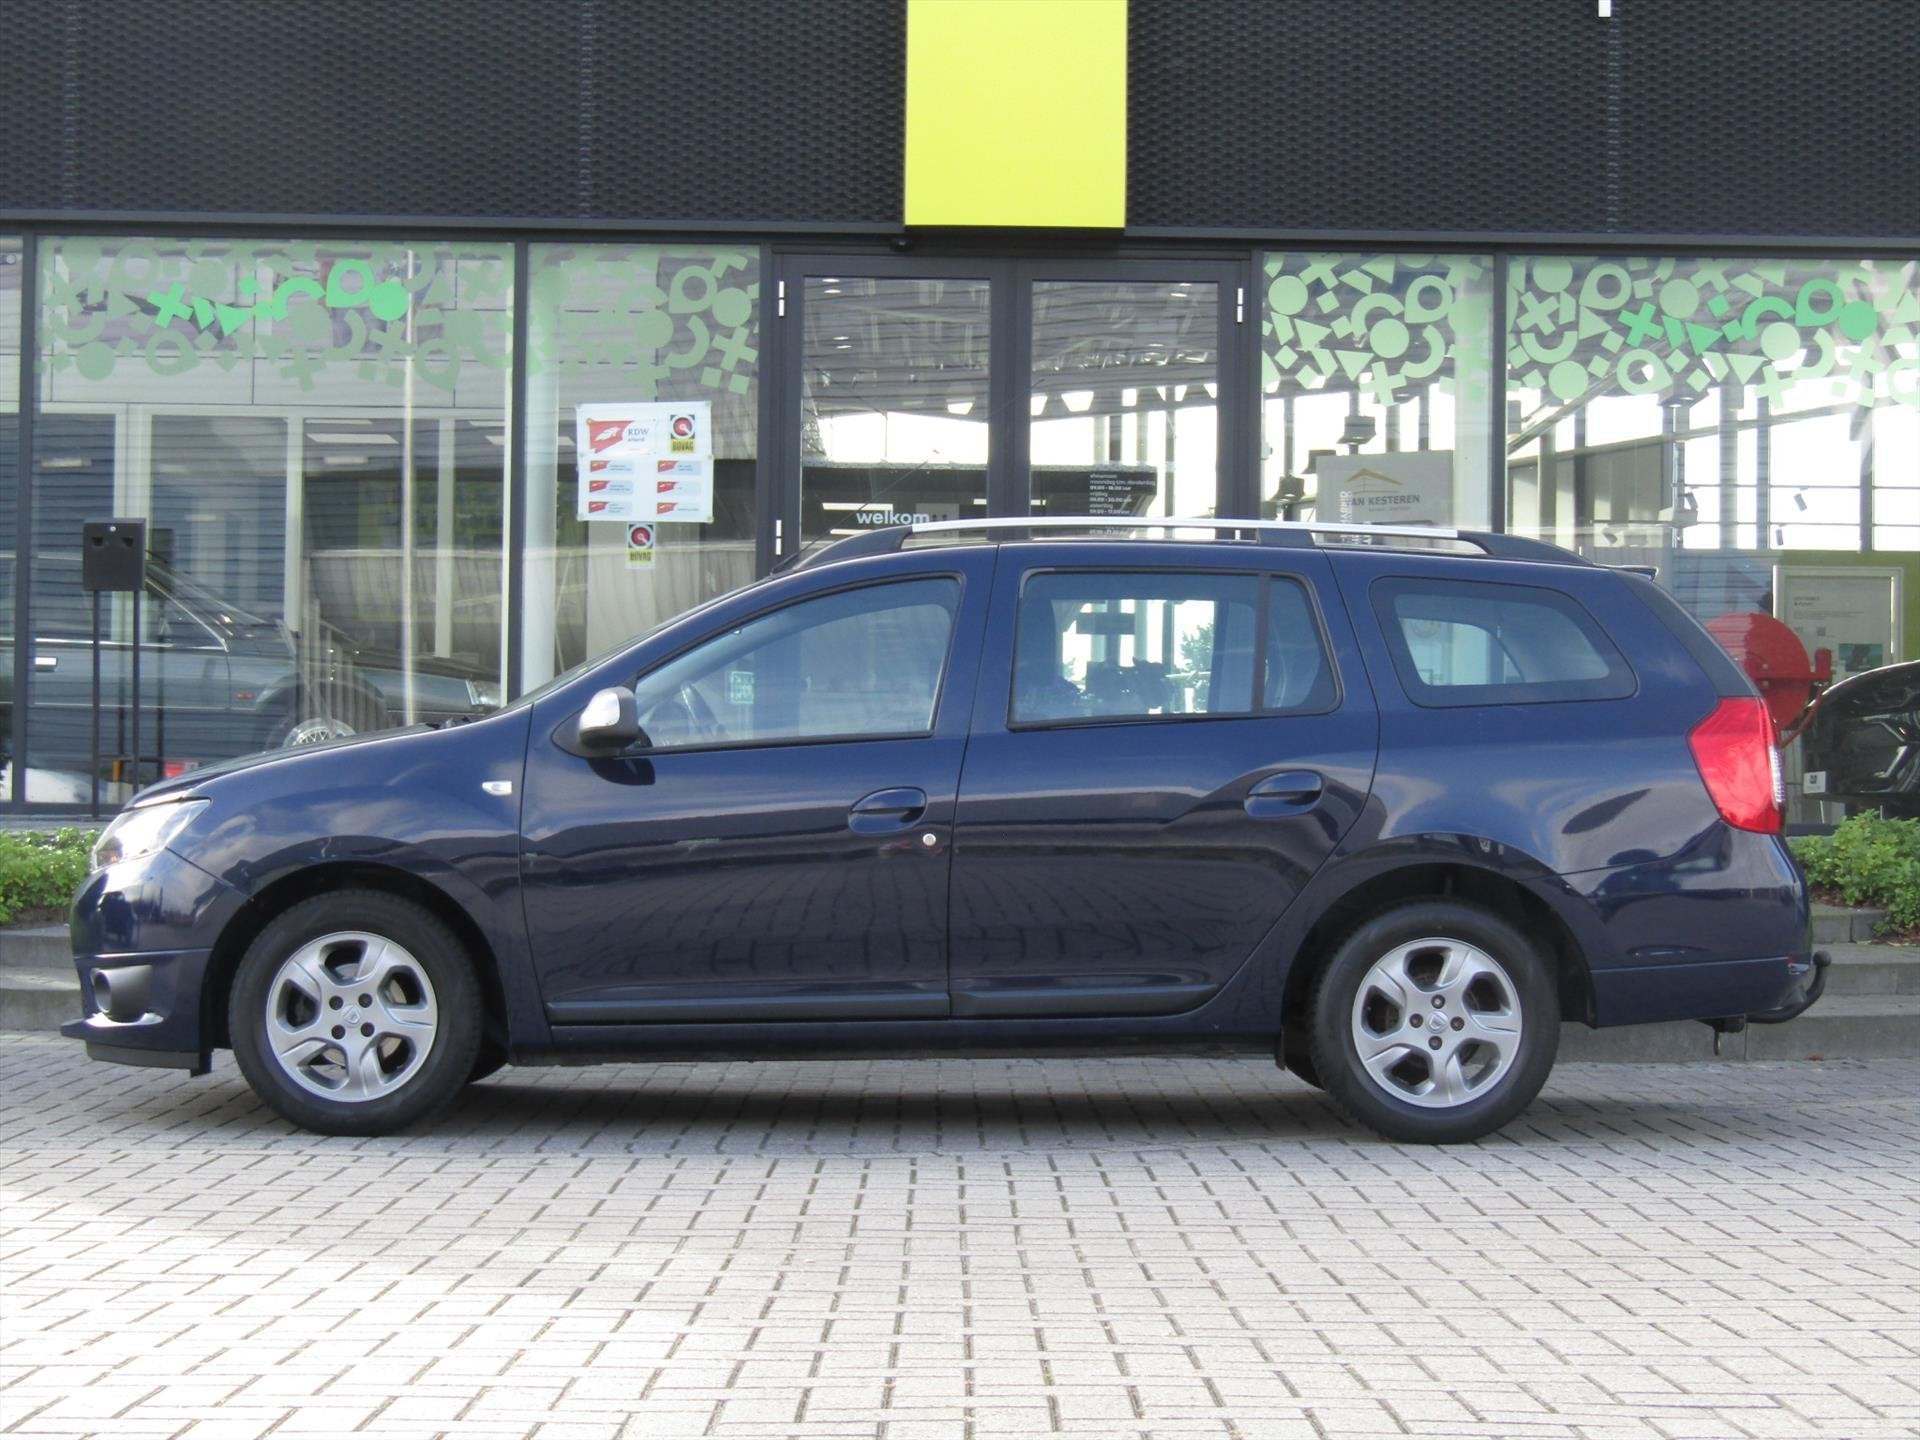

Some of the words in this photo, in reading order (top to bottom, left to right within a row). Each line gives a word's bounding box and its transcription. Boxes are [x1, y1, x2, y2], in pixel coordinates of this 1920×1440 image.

[628, 428, 648, 436] RDW
[672, 441, 694, 451] BOVAG
[1368, 495, 1421, 505] KESTEREN
[856, 510, 930, 524] welkom
